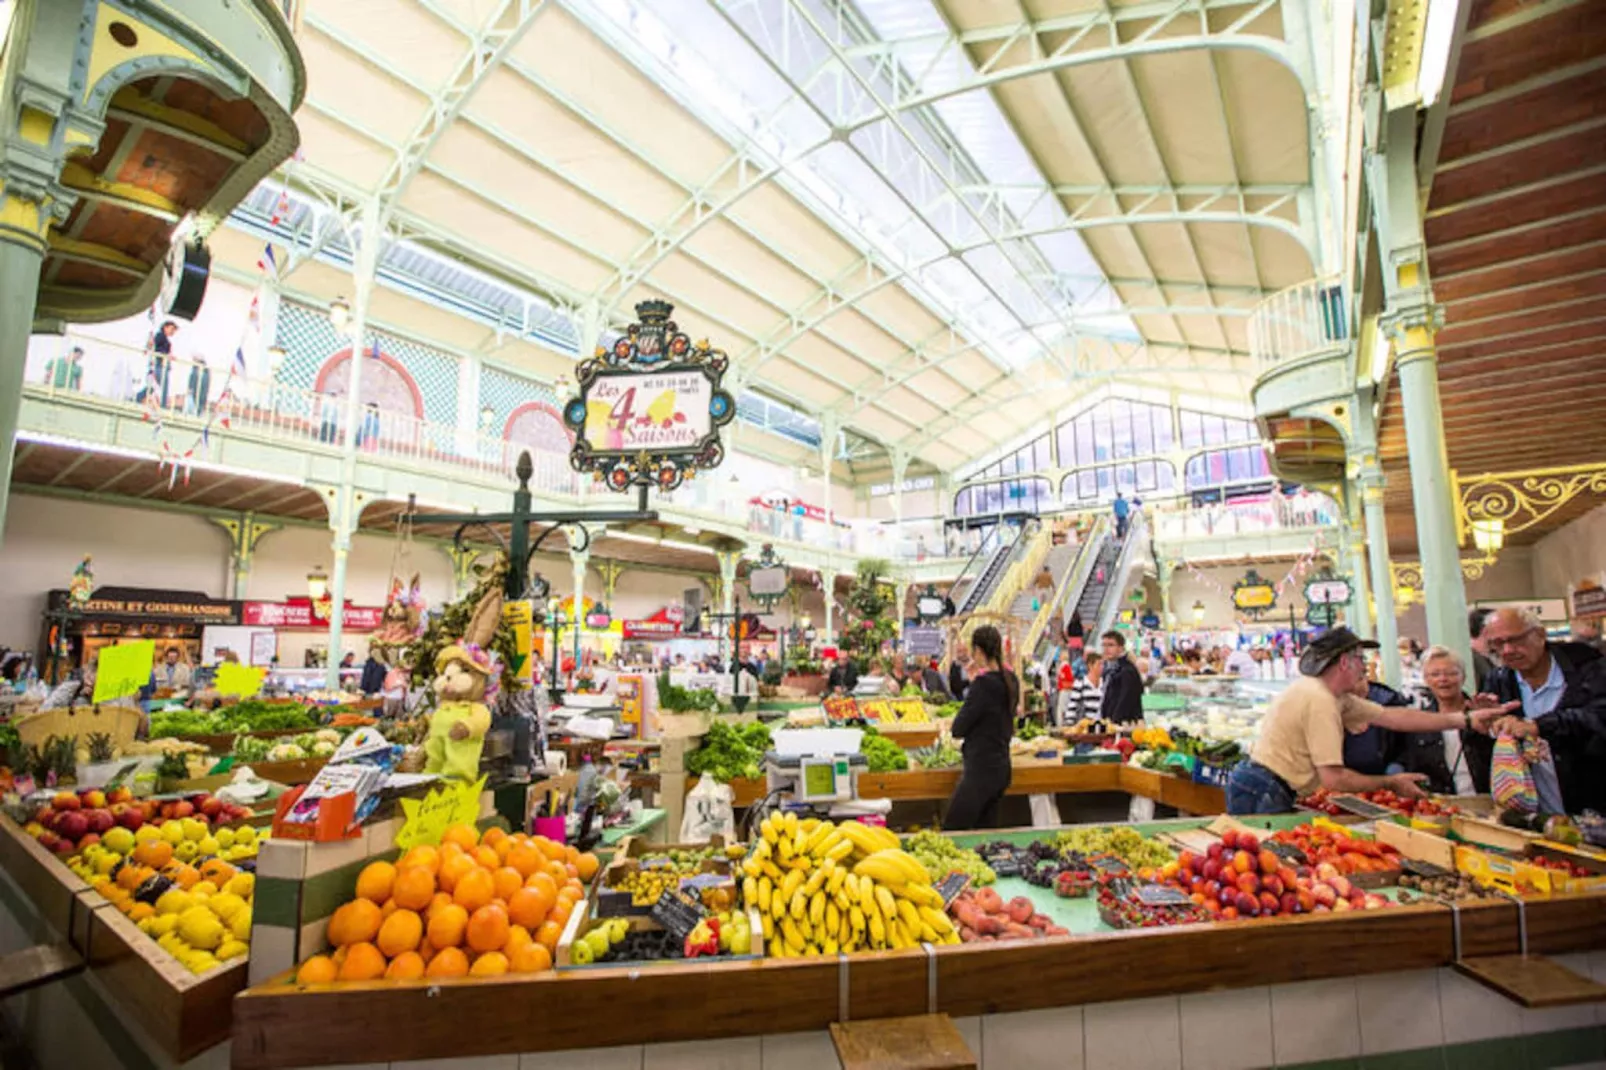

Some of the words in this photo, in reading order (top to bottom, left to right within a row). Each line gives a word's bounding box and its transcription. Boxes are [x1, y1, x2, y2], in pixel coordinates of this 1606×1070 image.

[595, 382, 619, 397] Les
[608, 387, 636, 431] 4
[624, 426, 698, 443] Saisons
